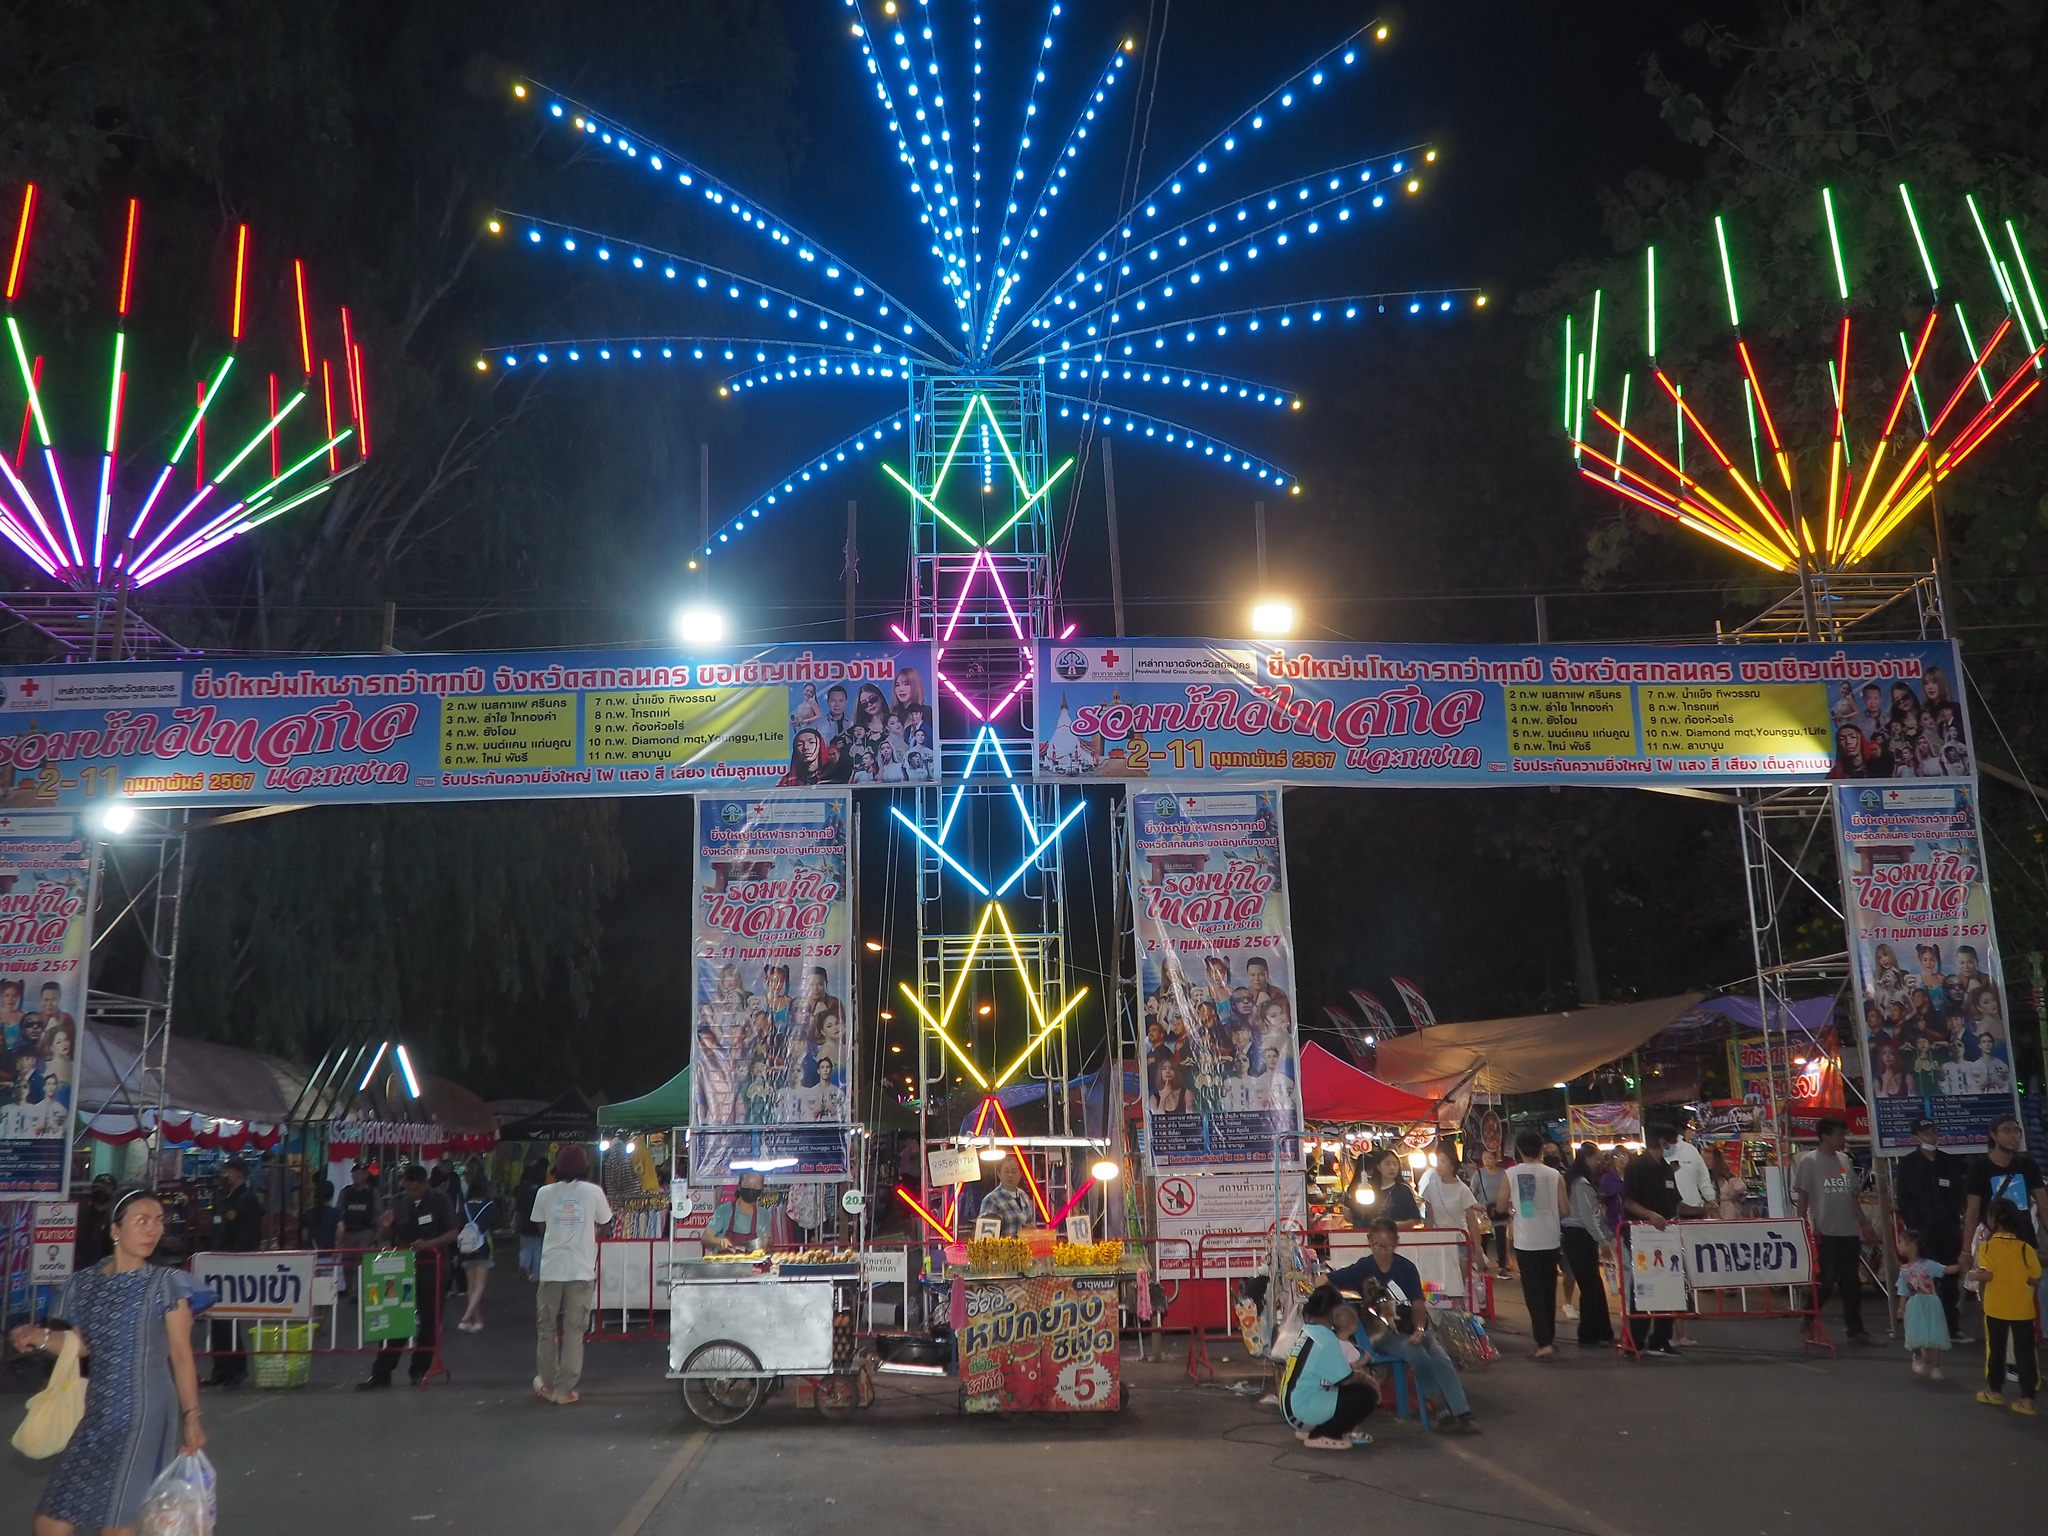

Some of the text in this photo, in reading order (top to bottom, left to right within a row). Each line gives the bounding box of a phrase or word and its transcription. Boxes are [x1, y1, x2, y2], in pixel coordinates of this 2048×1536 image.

[195, 652, 895, 697] ยิ่งใหญ่มโหฬารกว่าทุกปี จังหวัดสกลนคร ขอเชิญเที่ยวงาน
[1267, 649, 1922, 686] ยิ่งใหญ่มโหฬารกว่าทุกปี จังหวัดสกลนคร ขอเชิญเที่ยวงาน
[588, 738, 601, 746] 10
[632, 735, 680, 745] Diamond
[1686, 728, 1730, 737] Diamond
[588, 751, 600, 760] 11
[1127, 739, 1336, 770] 2-11 กุมภาพันธ์ 2567
[1346, 743, 1482, 773] และกาชาด
[1513, 756, 1652, 773] รับประกันความยิ่งใหญ่
[1656, 759, 1673, 772] ไฟ
[1678, 759, 1706, 771] แสง
[1711, 756, 1720, 771] สี
[1725, 756, 1758, 771] เสียง
[37, 765, 255, 798] 2-11 กุมภาพันธ์ 2567
[265, 759, 409, 792] และกาชาด
[442, 766, 591, 786] รับประกันความยิ่งใหญ่
[596, 768, 614, 782] ไฟ
[619, 769, 649, 781] แสง
[654, 765, 665, 780] สี
[1952, 924, 1989, 936] 2567
[805, 944, 842, 957] 2567
[1243, 935, 1281, 948] 2567
[42, 960, 78, 972] 2567
[1352, 1140, 1369, 1152] 60
[677, 1202, 684, 1211] 5
[981, 1222, 997, 1239] 5
[1070, 1218, 1089, 1240] 10
[1695, 1231, 1798, 1273] ทางเข้า
[204, 1264, 300, 1304] ทางเข้า
[966, 1291, 1104, 1356] หมึกย่าง
[1052, 1327, 1114, 1366] ซีฟู้ด
[968, 1372, 1004, 1394] รสเด็ด
[1074, 1368, 1095, 1402] 5
